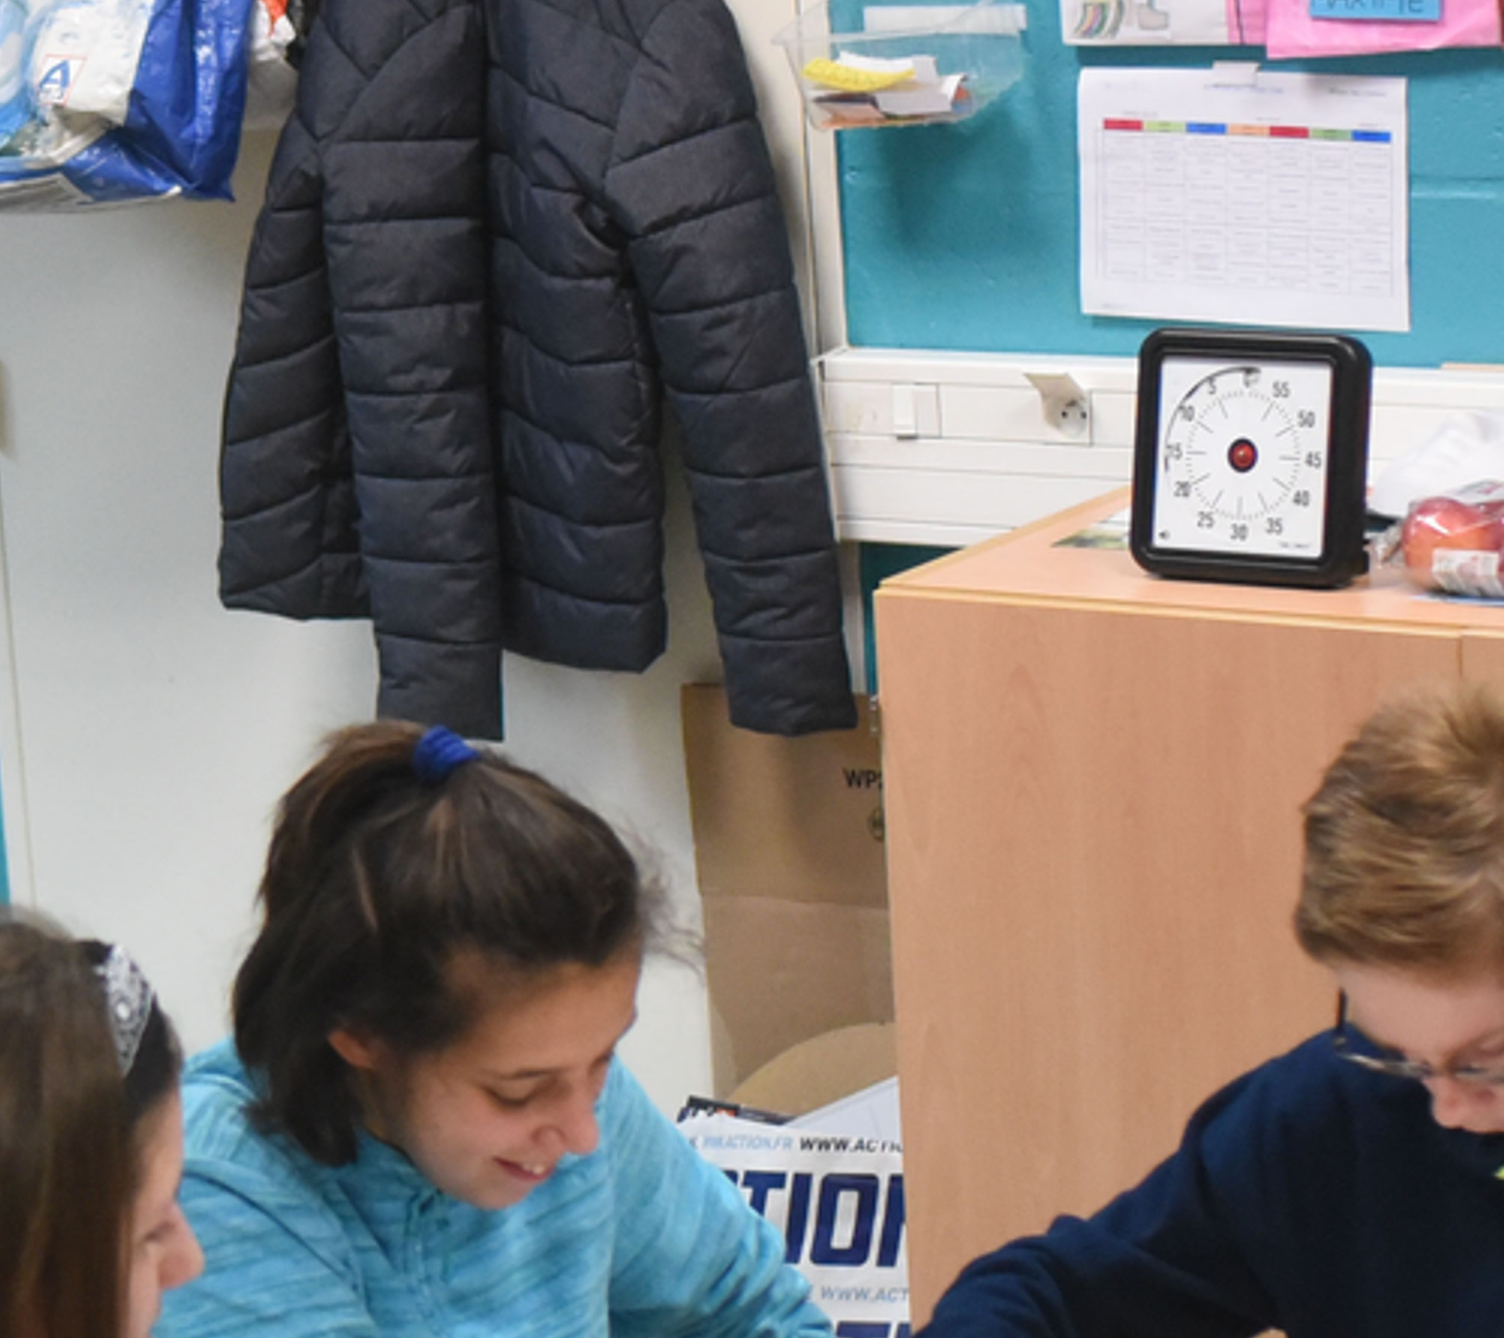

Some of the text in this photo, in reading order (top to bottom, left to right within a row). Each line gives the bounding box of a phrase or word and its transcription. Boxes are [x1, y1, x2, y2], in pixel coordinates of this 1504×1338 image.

[1272, 381, 1291, 398] 55
[1305, 452, 1322, 469] 45
[1293, 490, 1310, 507] 40
[1197, 511, 1215, 529] 25
[1266, 517, 1284, 535] 35
[1230, 523, 1248, 541] 30
